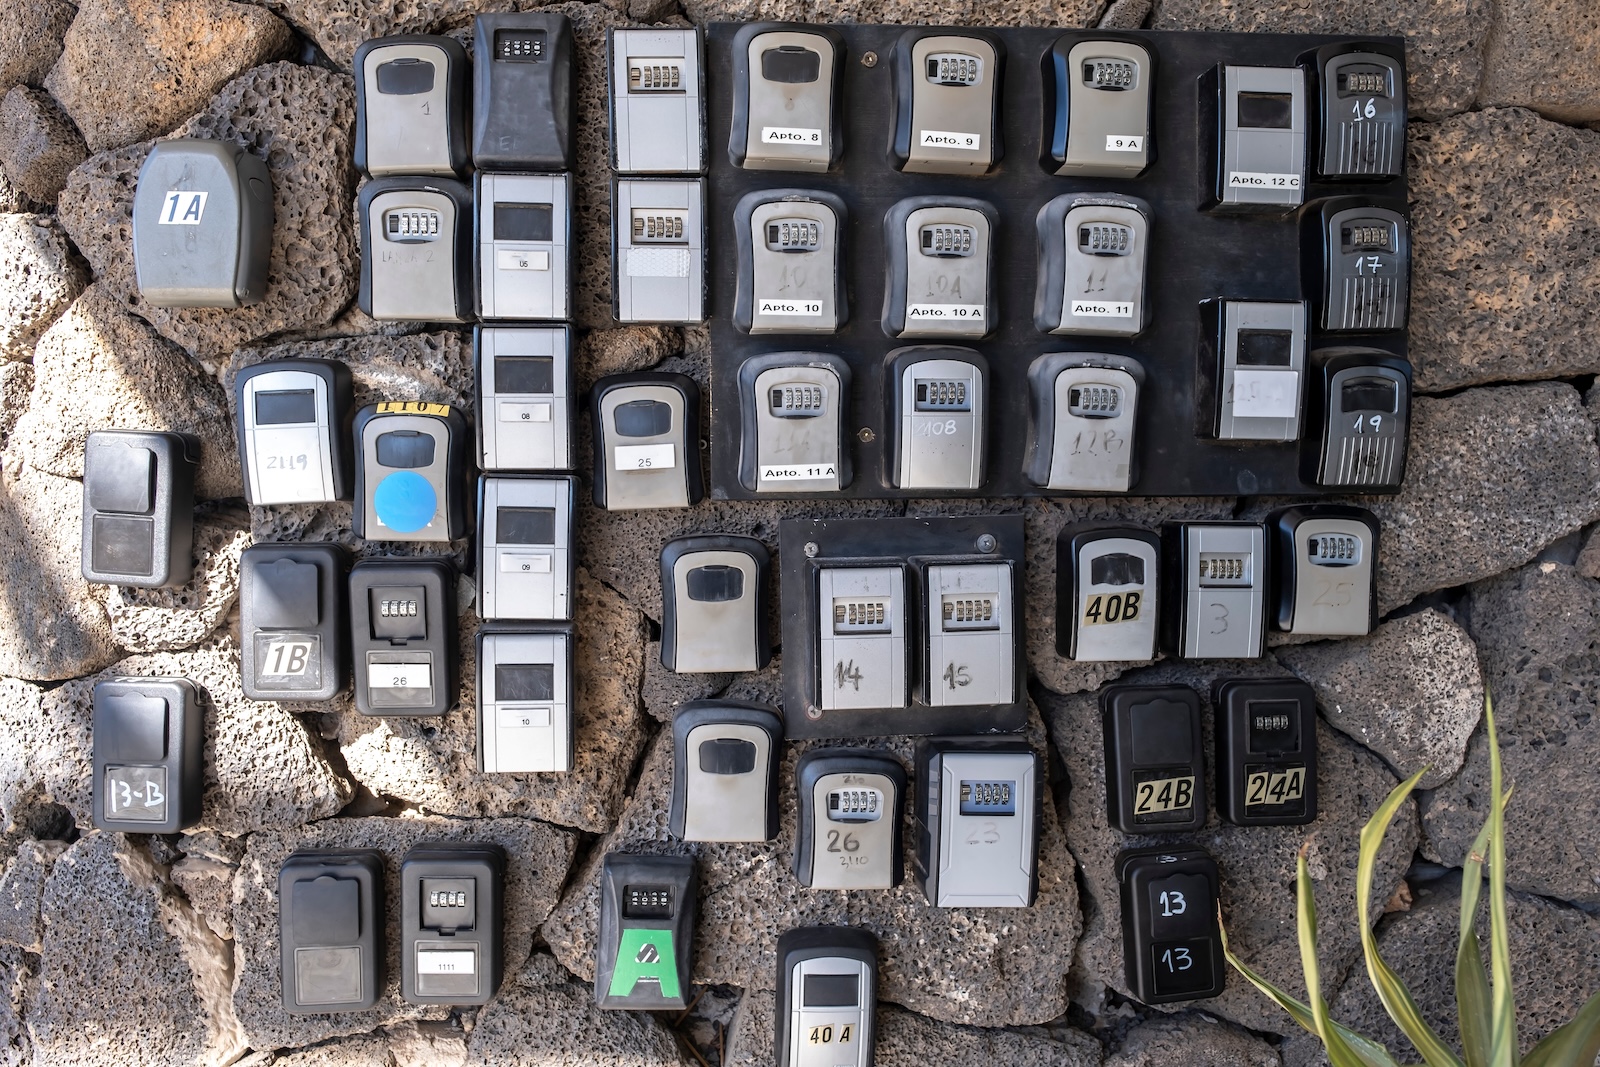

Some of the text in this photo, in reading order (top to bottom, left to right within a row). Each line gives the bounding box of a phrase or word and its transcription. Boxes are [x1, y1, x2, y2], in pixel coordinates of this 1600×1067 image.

[1352, 97, 1376, 121] 16
[769, 131, 819, 141] Apto. 8
[925, 135, 973, 146] Apto. 9
[1115, 139, 1138, 148] 9 A
[1231, 176, 1299, 186] Apto. 12 C
[168, 194, 201, 222] 1A
[1355, 255, 1383, 276] 17
[762, 303, 820, 313] Apto. 10
[910, 308, 982, 317] Apto. 10 A
[1074, 305, 1129, 314] Apto. 11
[521, 412, 531, 420] 08
[1353, 414, 1382, 434] 19
[638, 457, 652, 468] 25
[765, 467, 835, 477] Apto. 11 A
[1086, 592, 1140, 624] 40B
[1210, 603, 1230, 635] 3
[273, 645, 308, 673] 1B
[392, 676, 408, 686] 26
[834, 658, 864, 692] 14
[943, 660, 973, 691] 15
[521, 718, 531, 726] 10
[111, 779, 165, 813] 13-B
[1137, 779, 1192, 813] 24B
[1249, 771, 1301, 803] 24A
[827, 829, 860, 853] 26
[1160, 891, 1187, 917] 13
[438, 963, 455, 971] 1111
[1162, 947, 1193, 973] 13
[810, 1026, 850, 1044] 40 A
